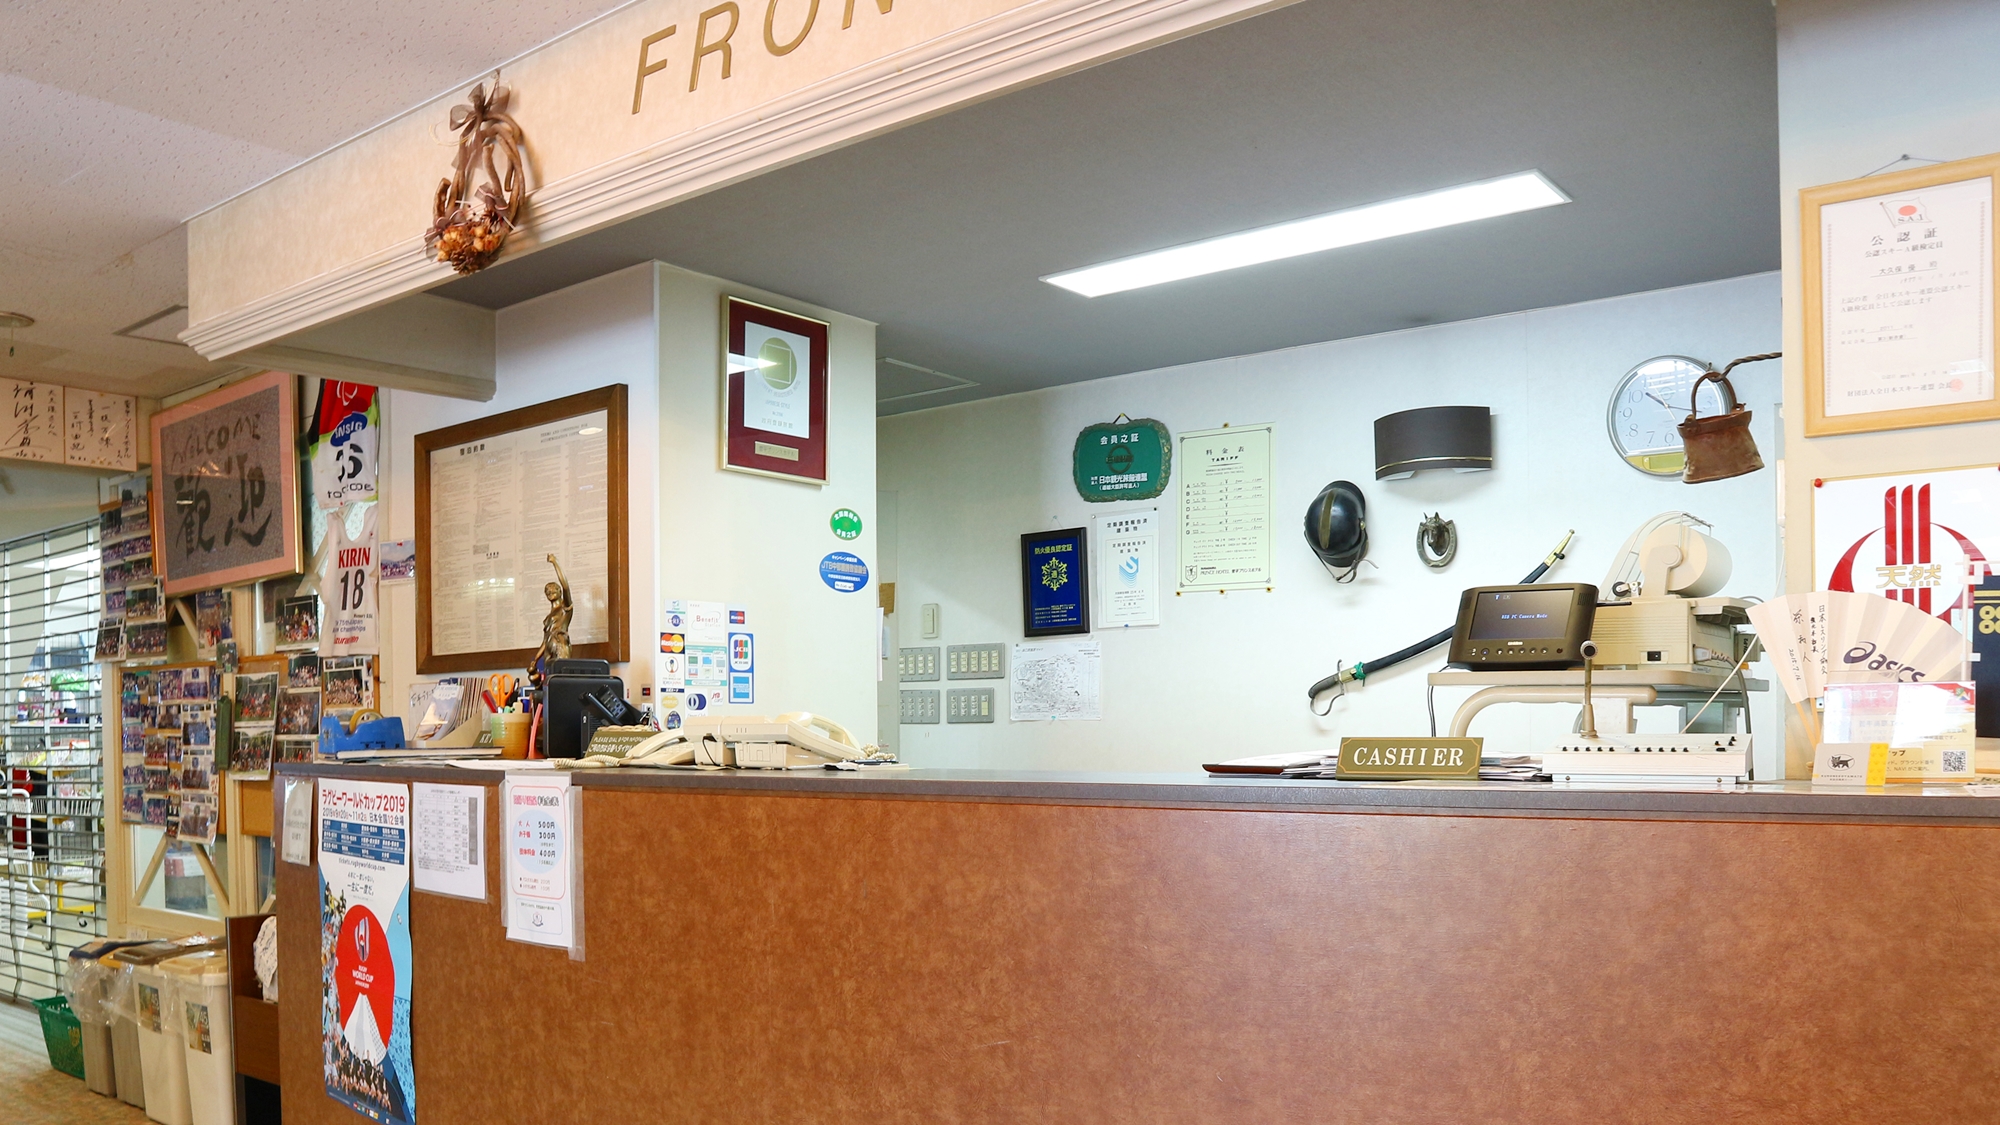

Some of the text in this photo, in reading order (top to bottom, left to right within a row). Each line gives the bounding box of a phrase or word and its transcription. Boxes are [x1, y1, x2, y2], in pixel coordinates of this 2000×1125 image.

[1897, 214, 1924, 223] SAJ
[1871, 227, 1938, 246] 公認証
[1623, 407, 1633, 420] 9
[1629, 423, 1639, 437] 8
[1100, 433, 1139, 445] 会員之証
[1646, 431, 1655, 444] 7
[1664, 432, 1675, 444] 6
[338, 547, 371, 569] KIRIN
[1876, 564, 1942, 588] 天然
[341, 568, 366, 611] 18
[1353, 747, 1464, 767] CASHIER
[322, 789, 405, 813] ラグビーワールドカップ2019
[538, 821, 555, 829] 500円
[539, 831, 556, 840] 300円
[539, 849, 556, 858] 400円
[339, 857, 386, 871] tickets.rugbyworldcup.com
[347, 882, 374, 896] 一生に一度だ。
